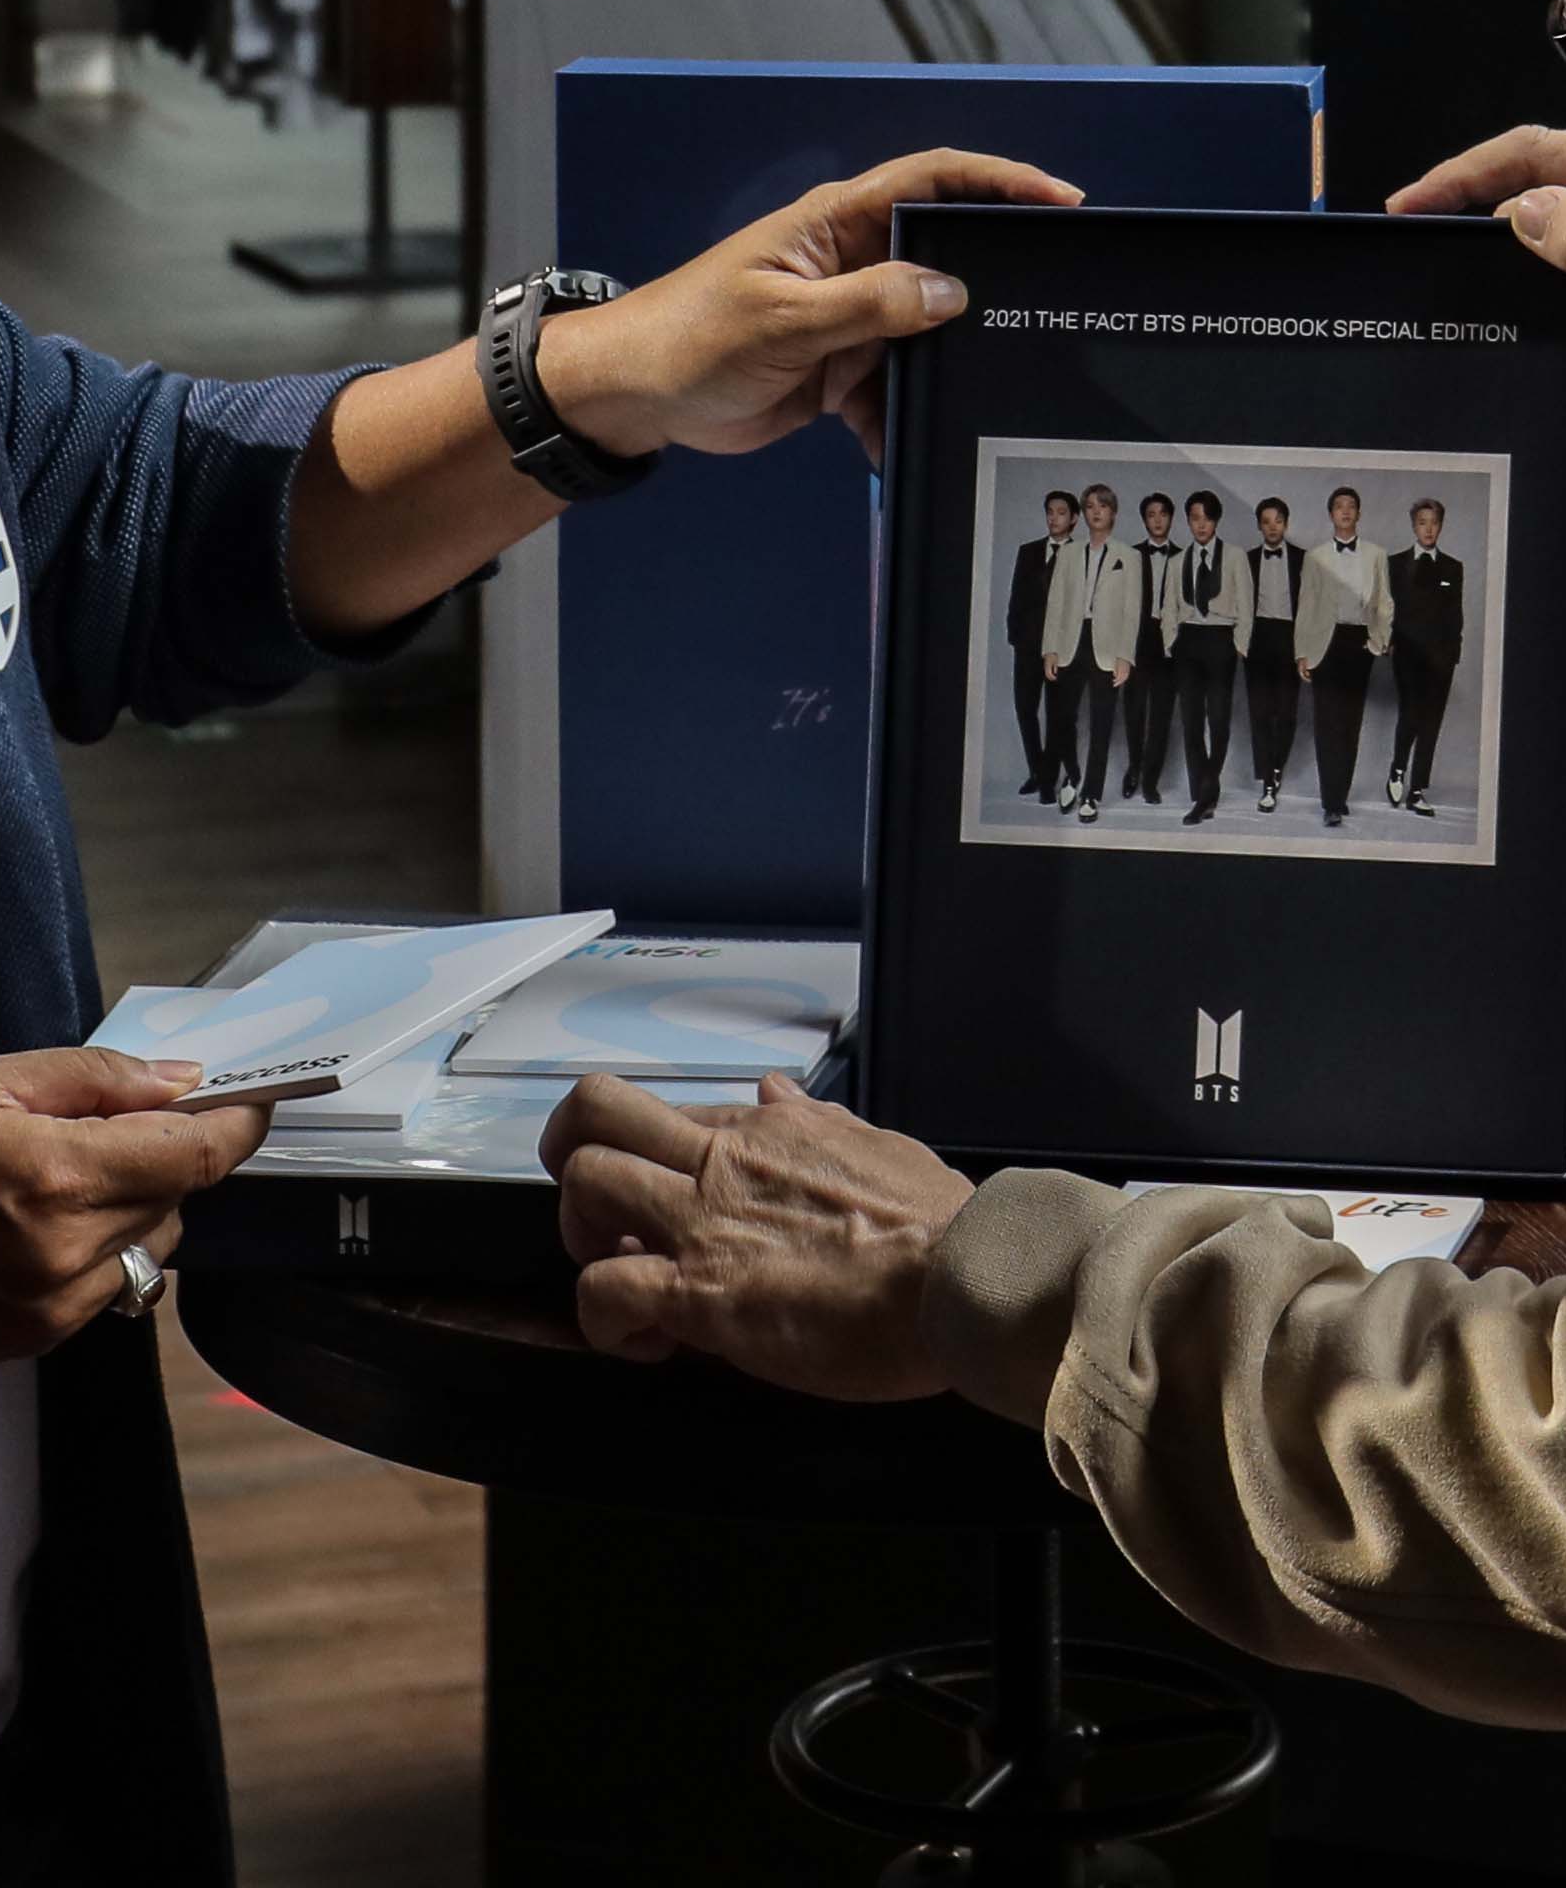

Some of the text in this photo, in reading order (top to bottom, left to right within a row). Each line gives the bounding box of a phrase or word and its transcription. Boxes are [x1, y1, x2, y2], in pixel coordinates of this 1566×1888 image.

[983, 308, 1518, 343] 2021 THE FACT BTS PHOTOBOOK SPECIAL EDITION
[1194, 1083, 1240, 1103] BTS
